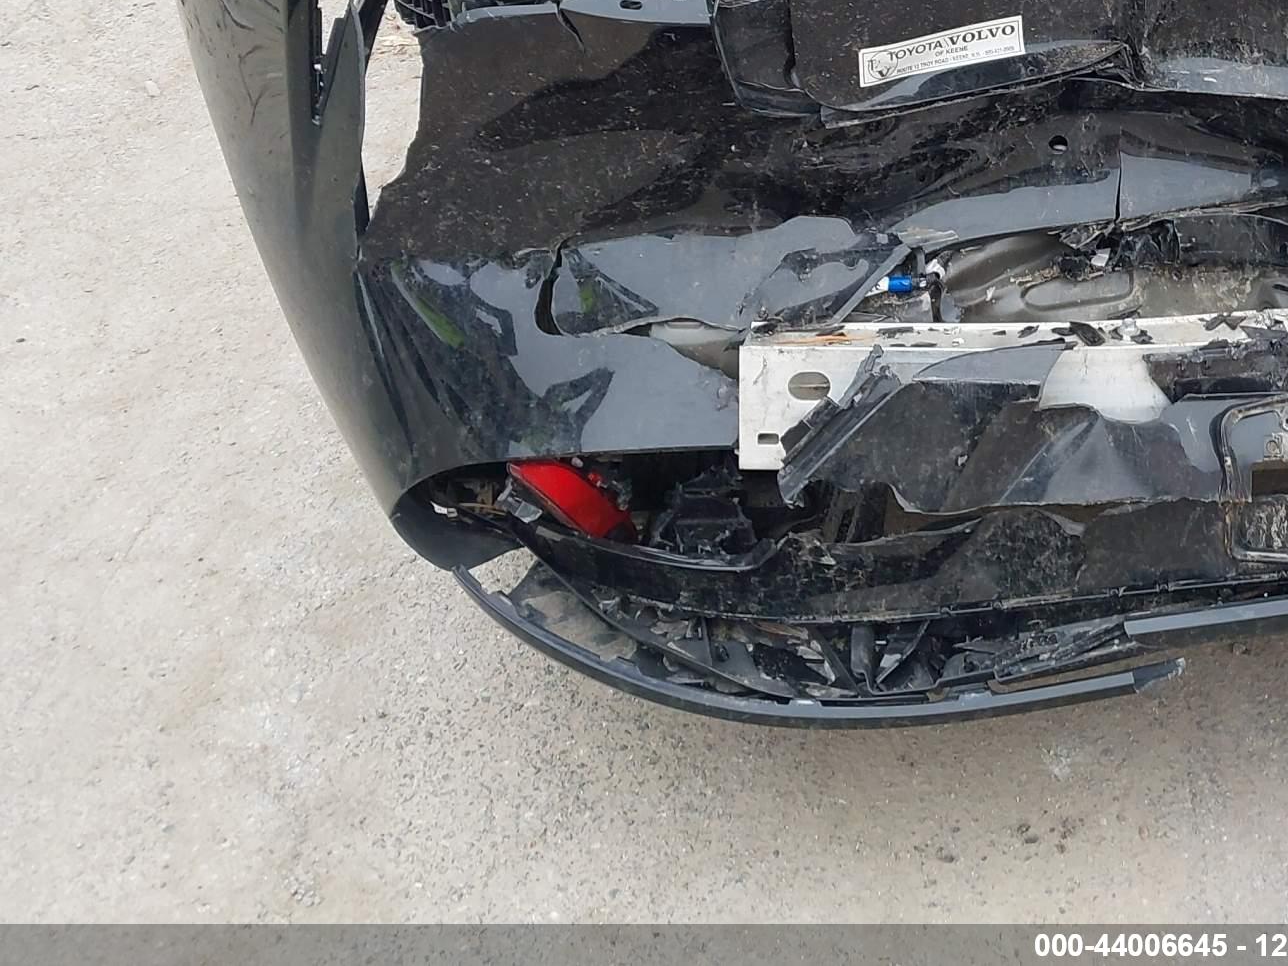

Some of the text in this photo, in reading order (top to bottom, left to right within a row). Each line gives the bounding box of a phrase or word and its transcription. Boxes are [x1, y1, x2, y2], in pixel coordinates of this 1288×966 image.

[887, 24, 1016, 62] TOYOTA VOLVO
[935, 45, 969, 58] OF KEENE
